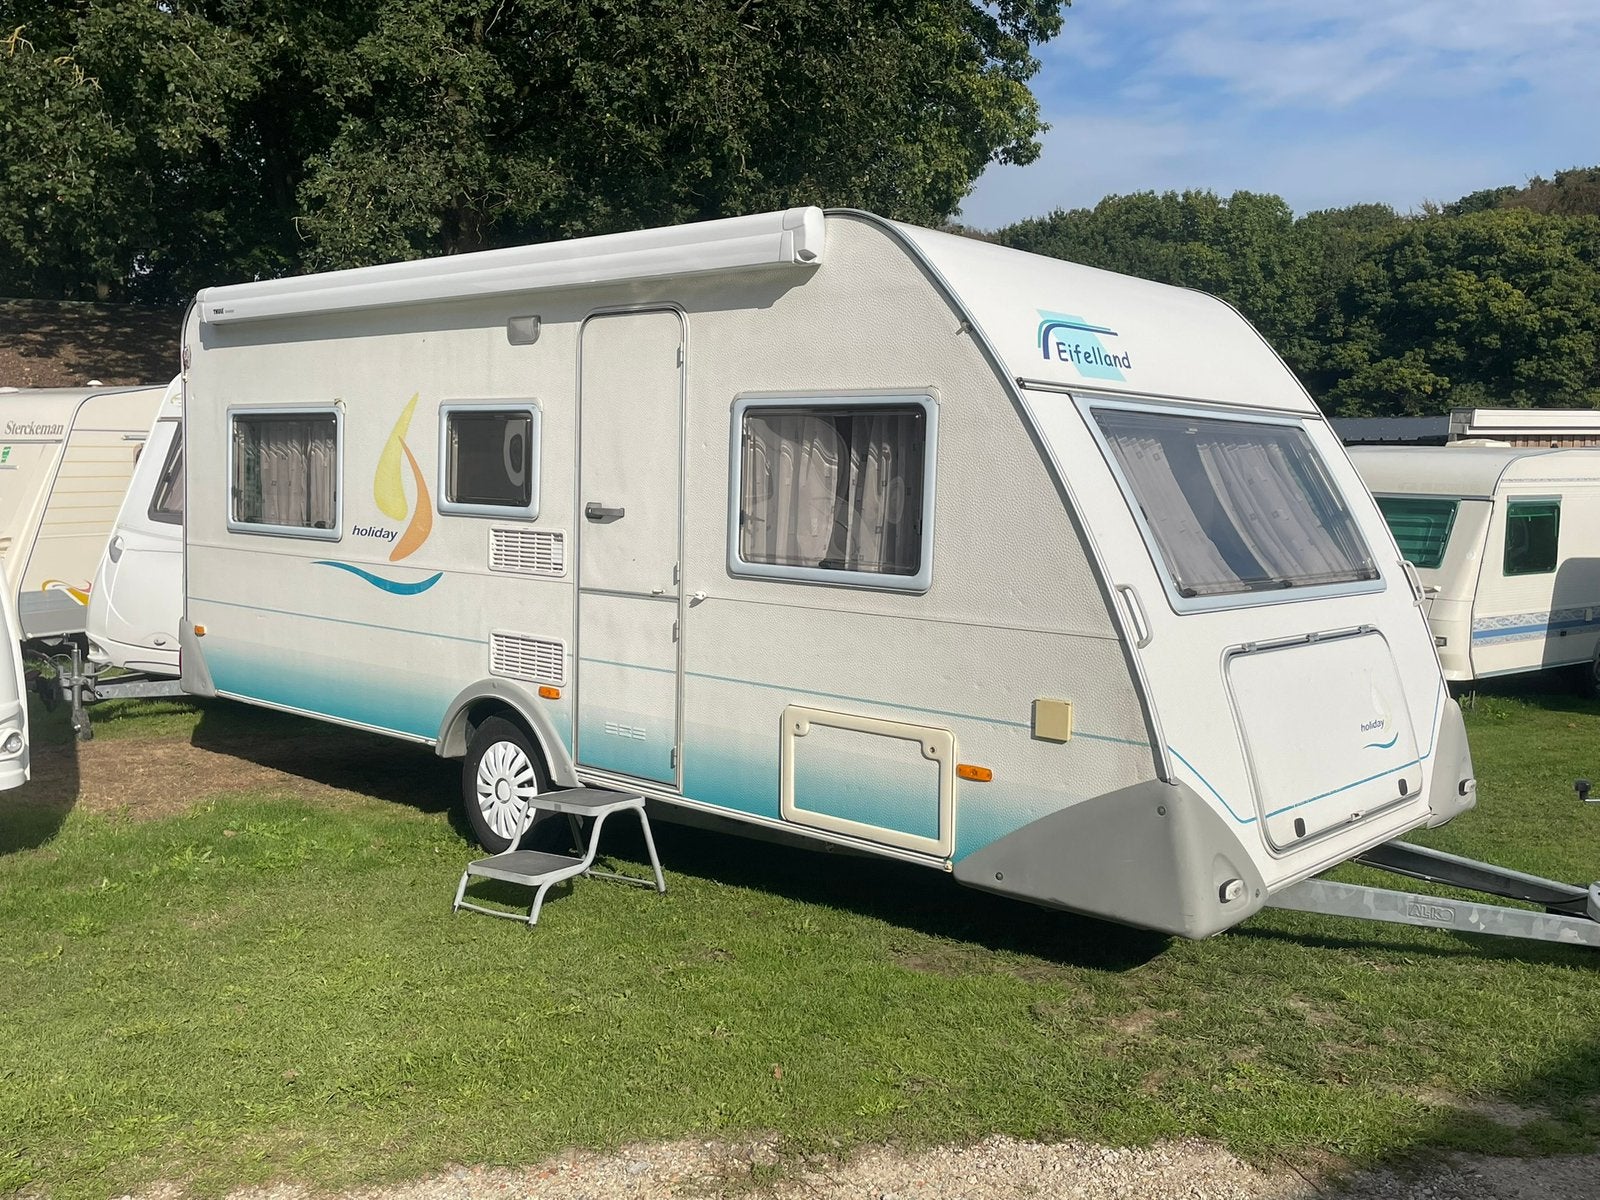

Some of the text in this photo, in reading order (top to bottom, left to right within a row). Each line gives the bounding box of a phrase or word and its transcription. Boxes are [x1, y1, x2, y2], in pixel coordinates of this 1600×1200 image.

[1056, 341, 1132, 369] Eifelland
[4, 420, 64, 435] Sterckeman
[352, 525, 398, 542] holiday
[1361, 719, 1384, 732] holiday
